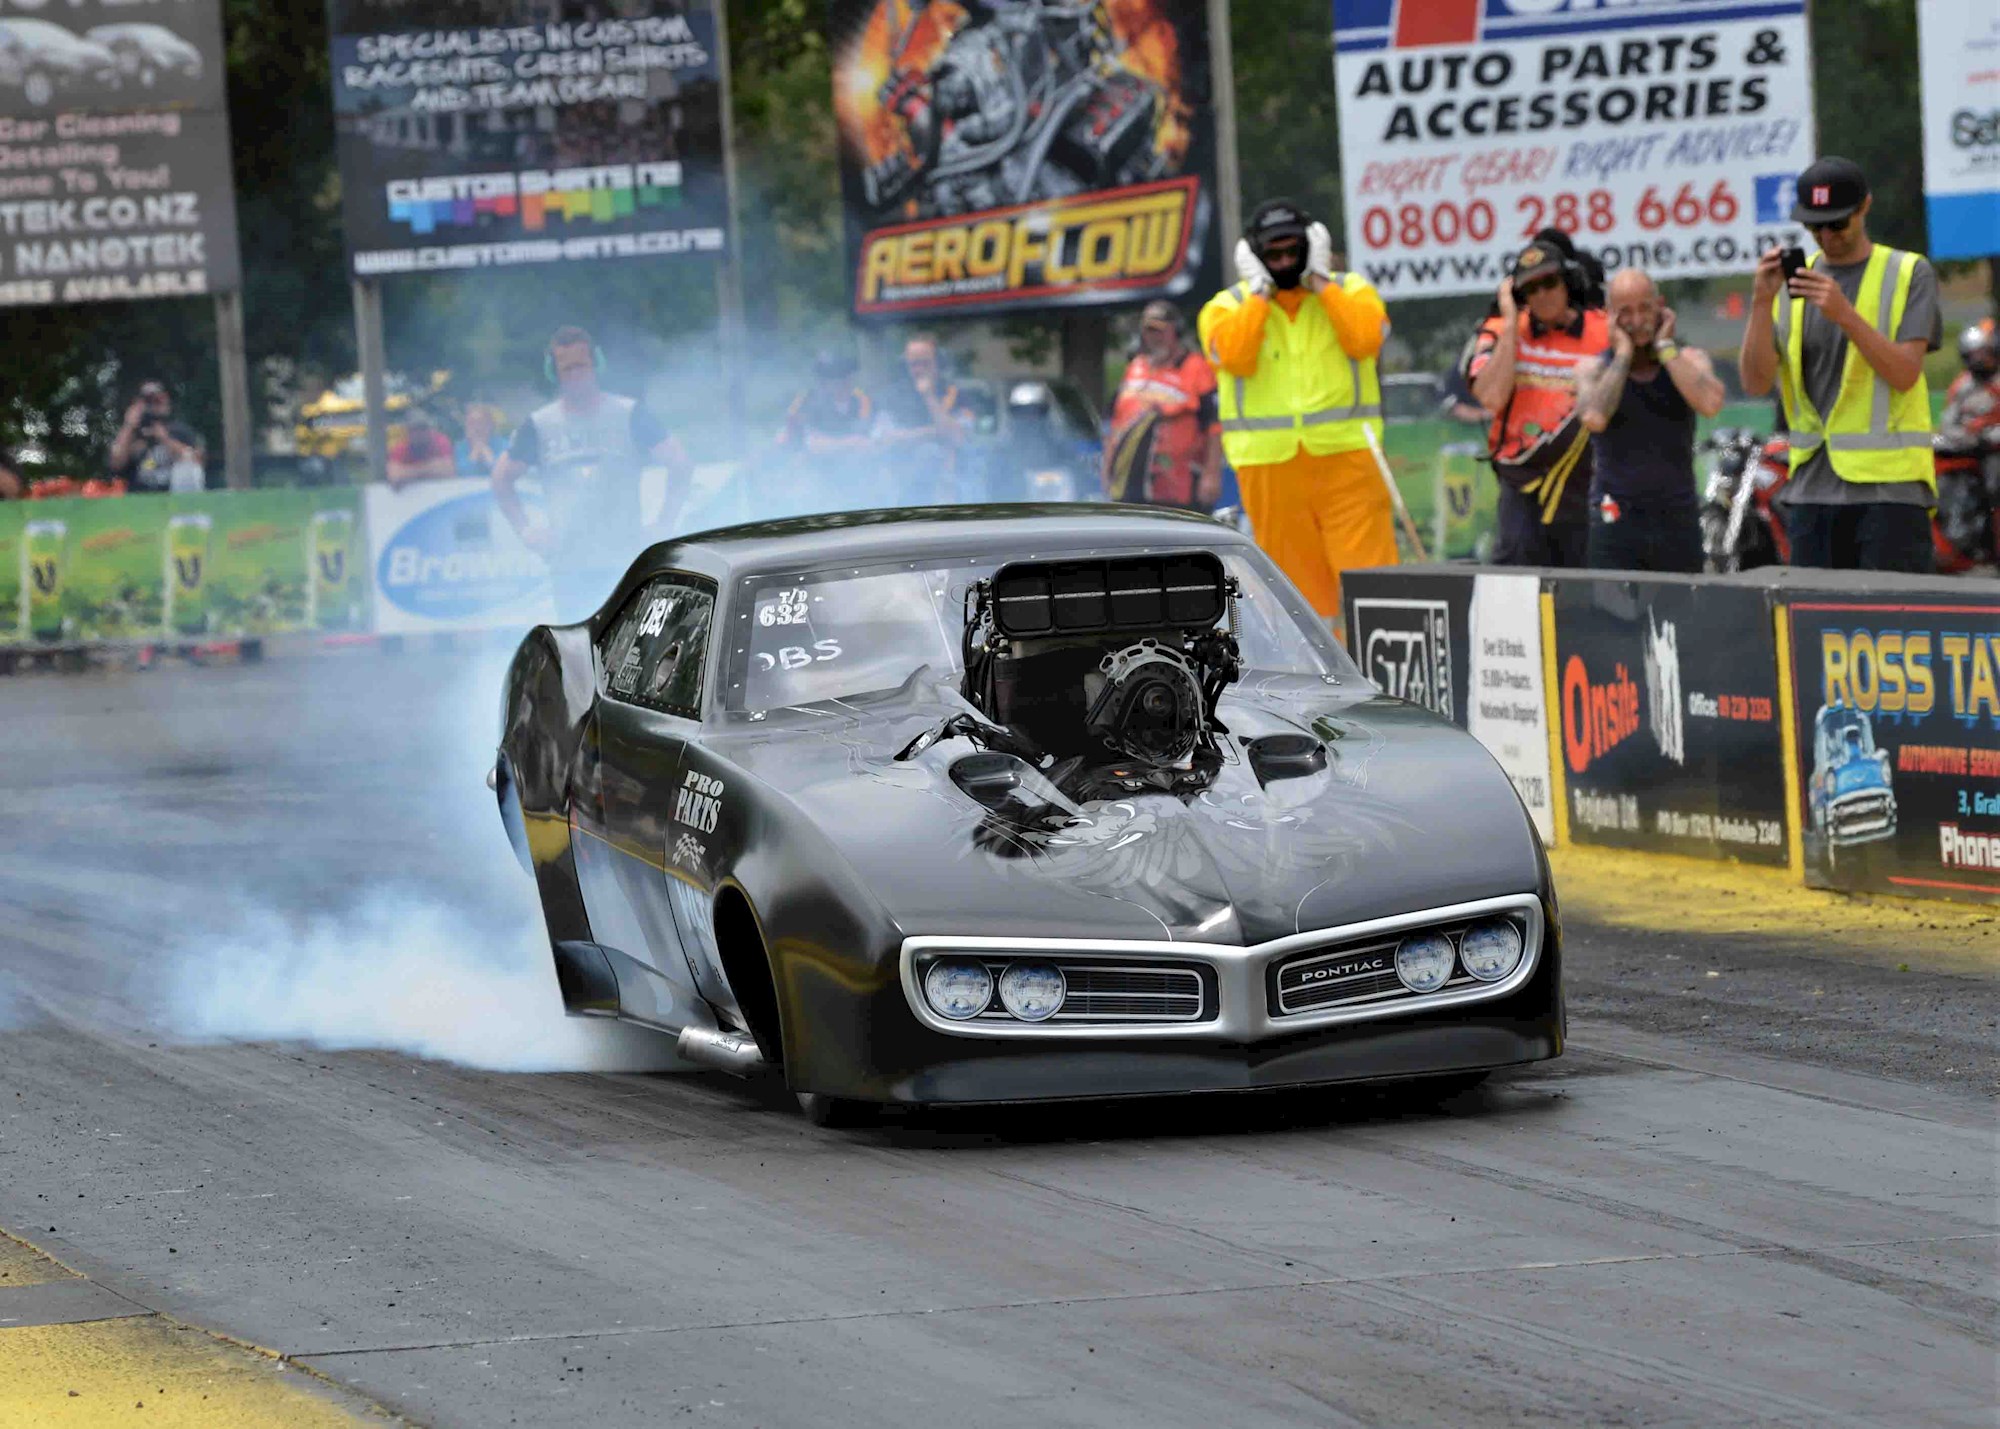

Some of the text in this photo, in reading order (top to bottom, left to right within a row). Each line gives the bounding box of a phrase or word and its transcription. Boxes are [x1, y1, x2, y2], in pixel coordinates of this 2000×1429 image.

[357, 14, 693, 62] SPECIALISTS IN CUSTOM
[1357, 30, 1786, 95] AUTO PARTS &
[410, 86, 471, 112] AND
[471, 78, 559, 110] TEAM
[1384, 77, 1768, 140] ACCESSORIES
[55, 113, 181, 137] Cleaning
[60, 168, 97, 192] To
[1358, 120, 1798, 200] RIGHT GEAR! RIGHT ADVICE!
[1363, 179, 1739, 248] 0800 288 666
[14, 233, 207, 276] NANOTEK
[863, 188, 1188, 302] AEROFLOW
[62, 271, 207, 301] AVAILABLE
[759, 602, 809, 627] 632
[779, 587, 808, 605] T/D
[1821, 629, 1935, 713] ROSS
[1562, 654, 1639, 774] Onsite
[1898, 744, 1968, 775] AUTOMOTIVE
[682, 769, 725, 798] PRO
[1957, 789, 1971, 816] 3,
[673, 787, 723, 834] PARTS
[1939, 824, 2000, 869] Phone
[1301, 959, 1384, 983] PONTIAC
